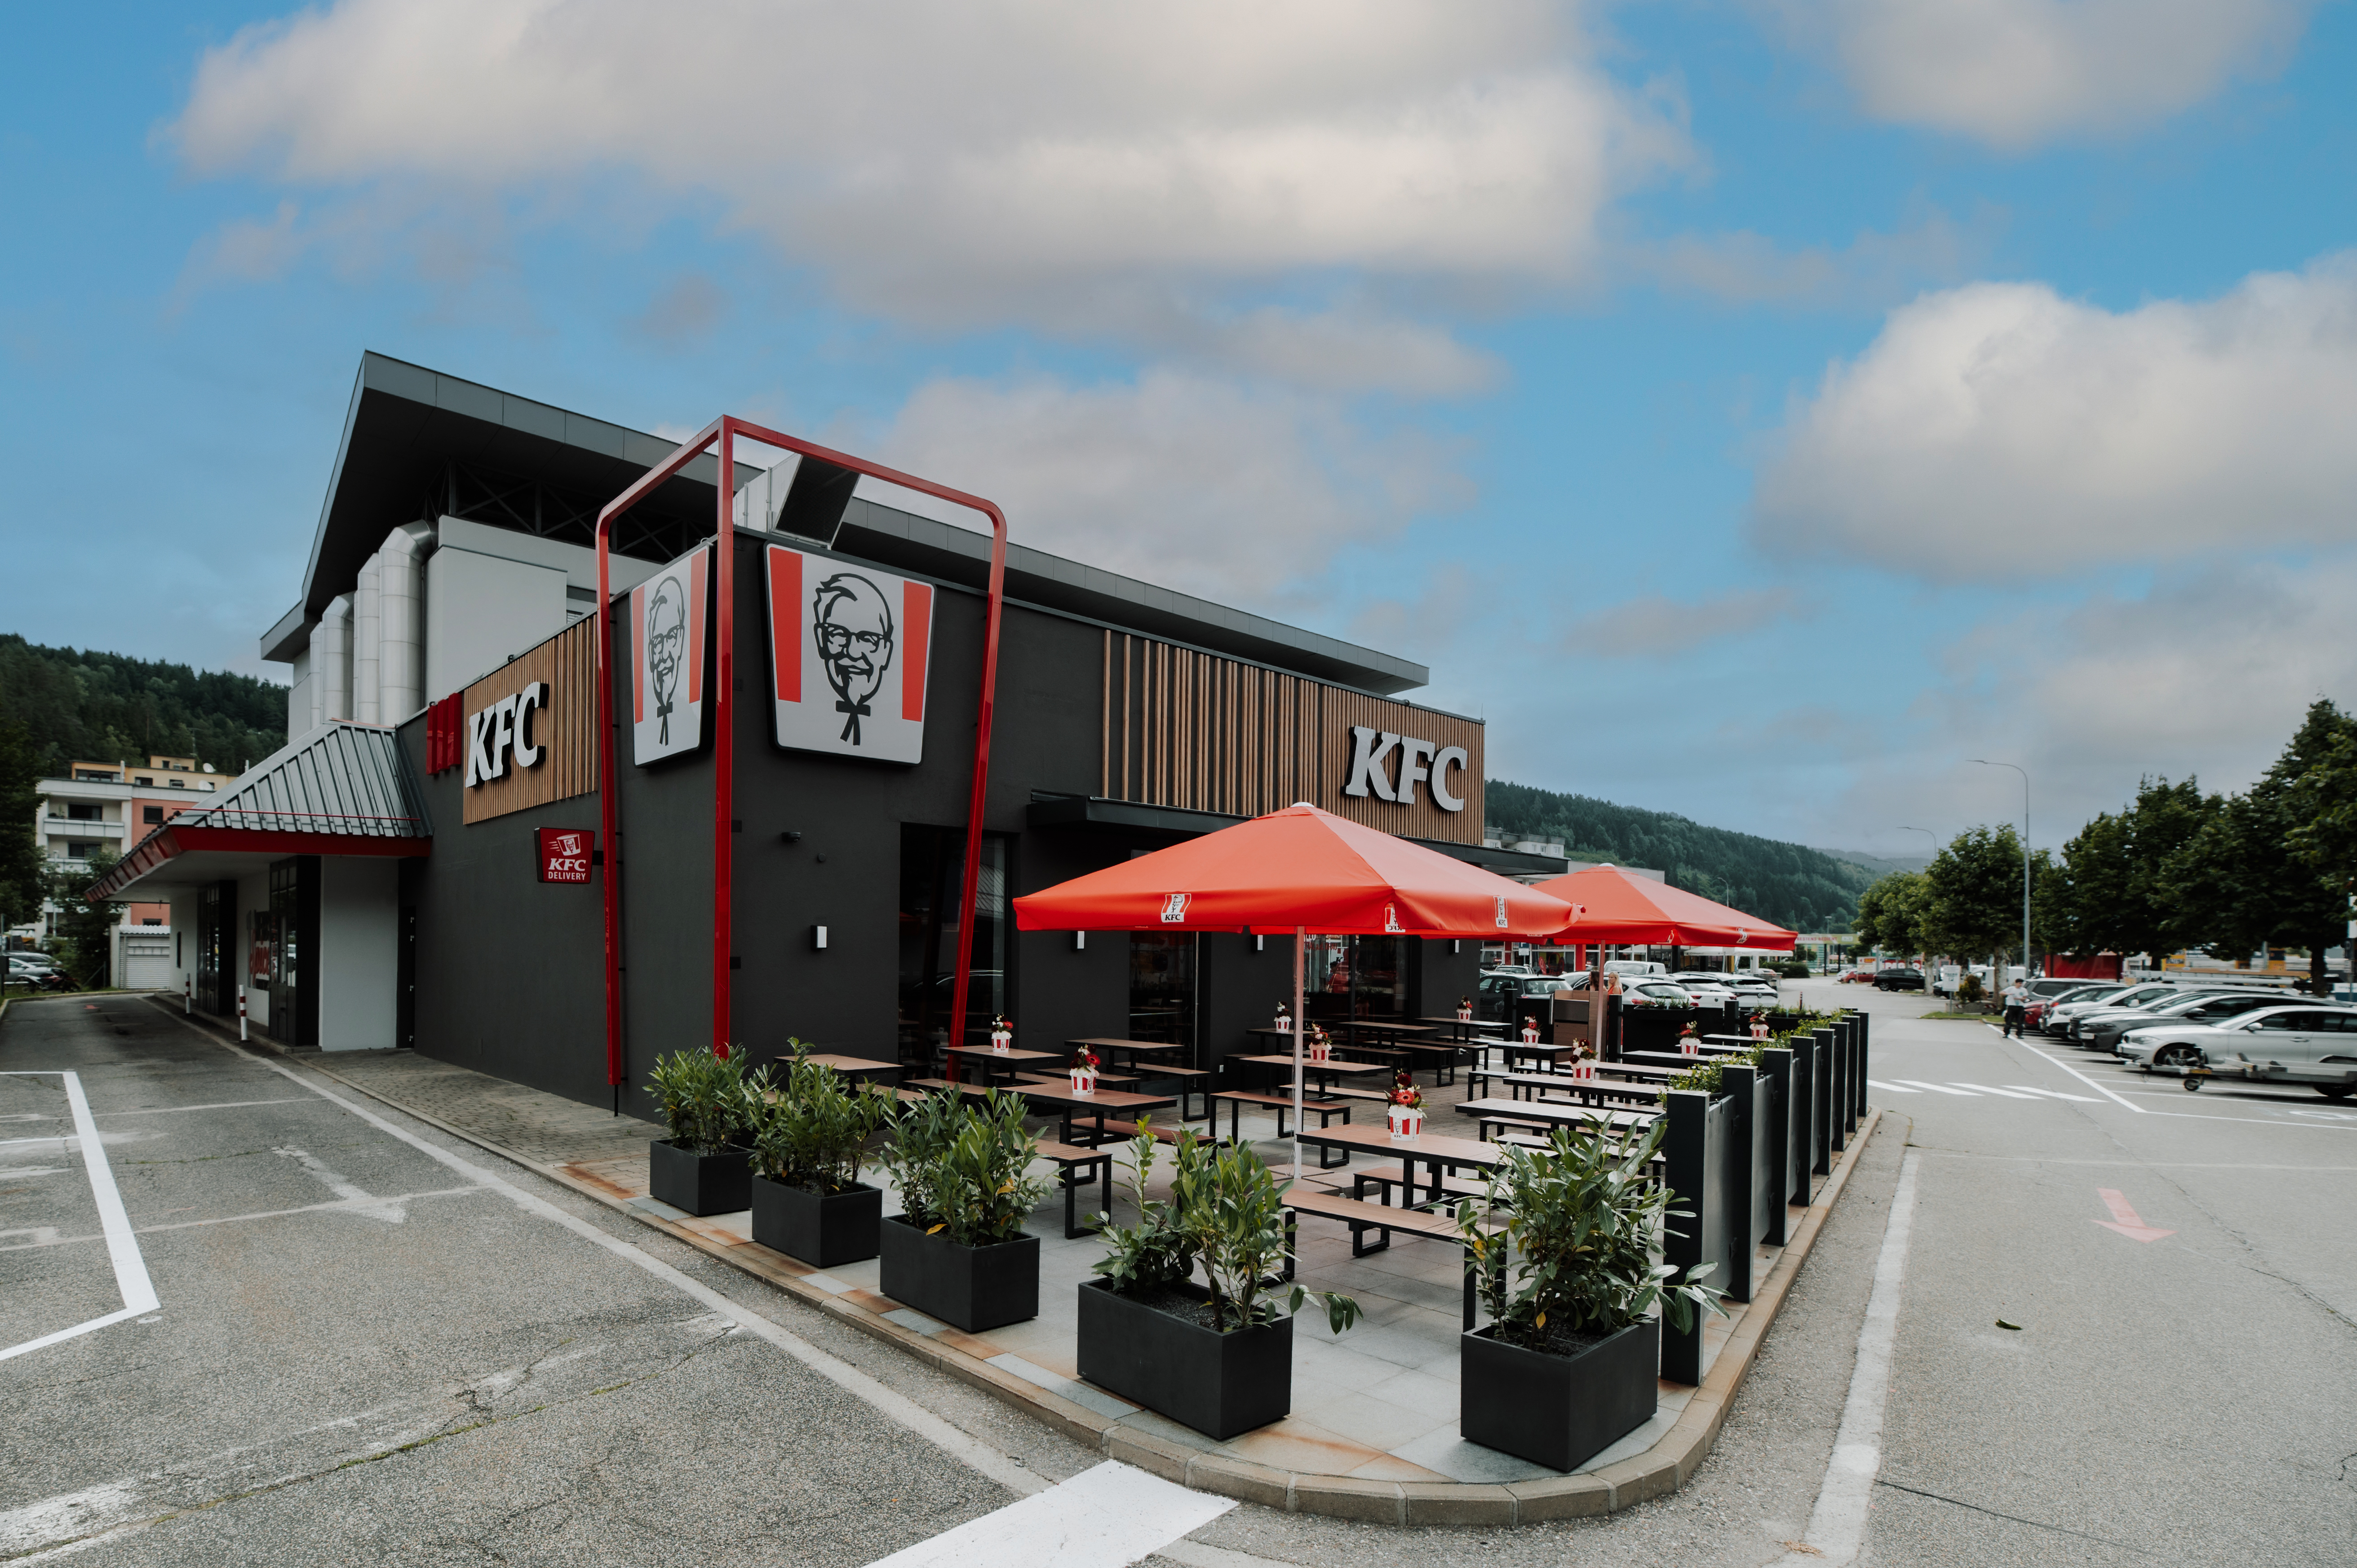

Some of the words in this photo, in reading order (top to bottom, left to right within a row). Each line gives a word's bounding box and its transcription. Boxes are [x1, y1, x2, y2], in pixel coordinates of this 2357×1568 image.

[465, 682, 541, 788] KFC
[1345, 726, 1467, 811] KFC
[548, 858, 586, 871] KFC
[548, 871, 586, 880] DELIVERY
[1885, 962, 1921, 970] PAGO
